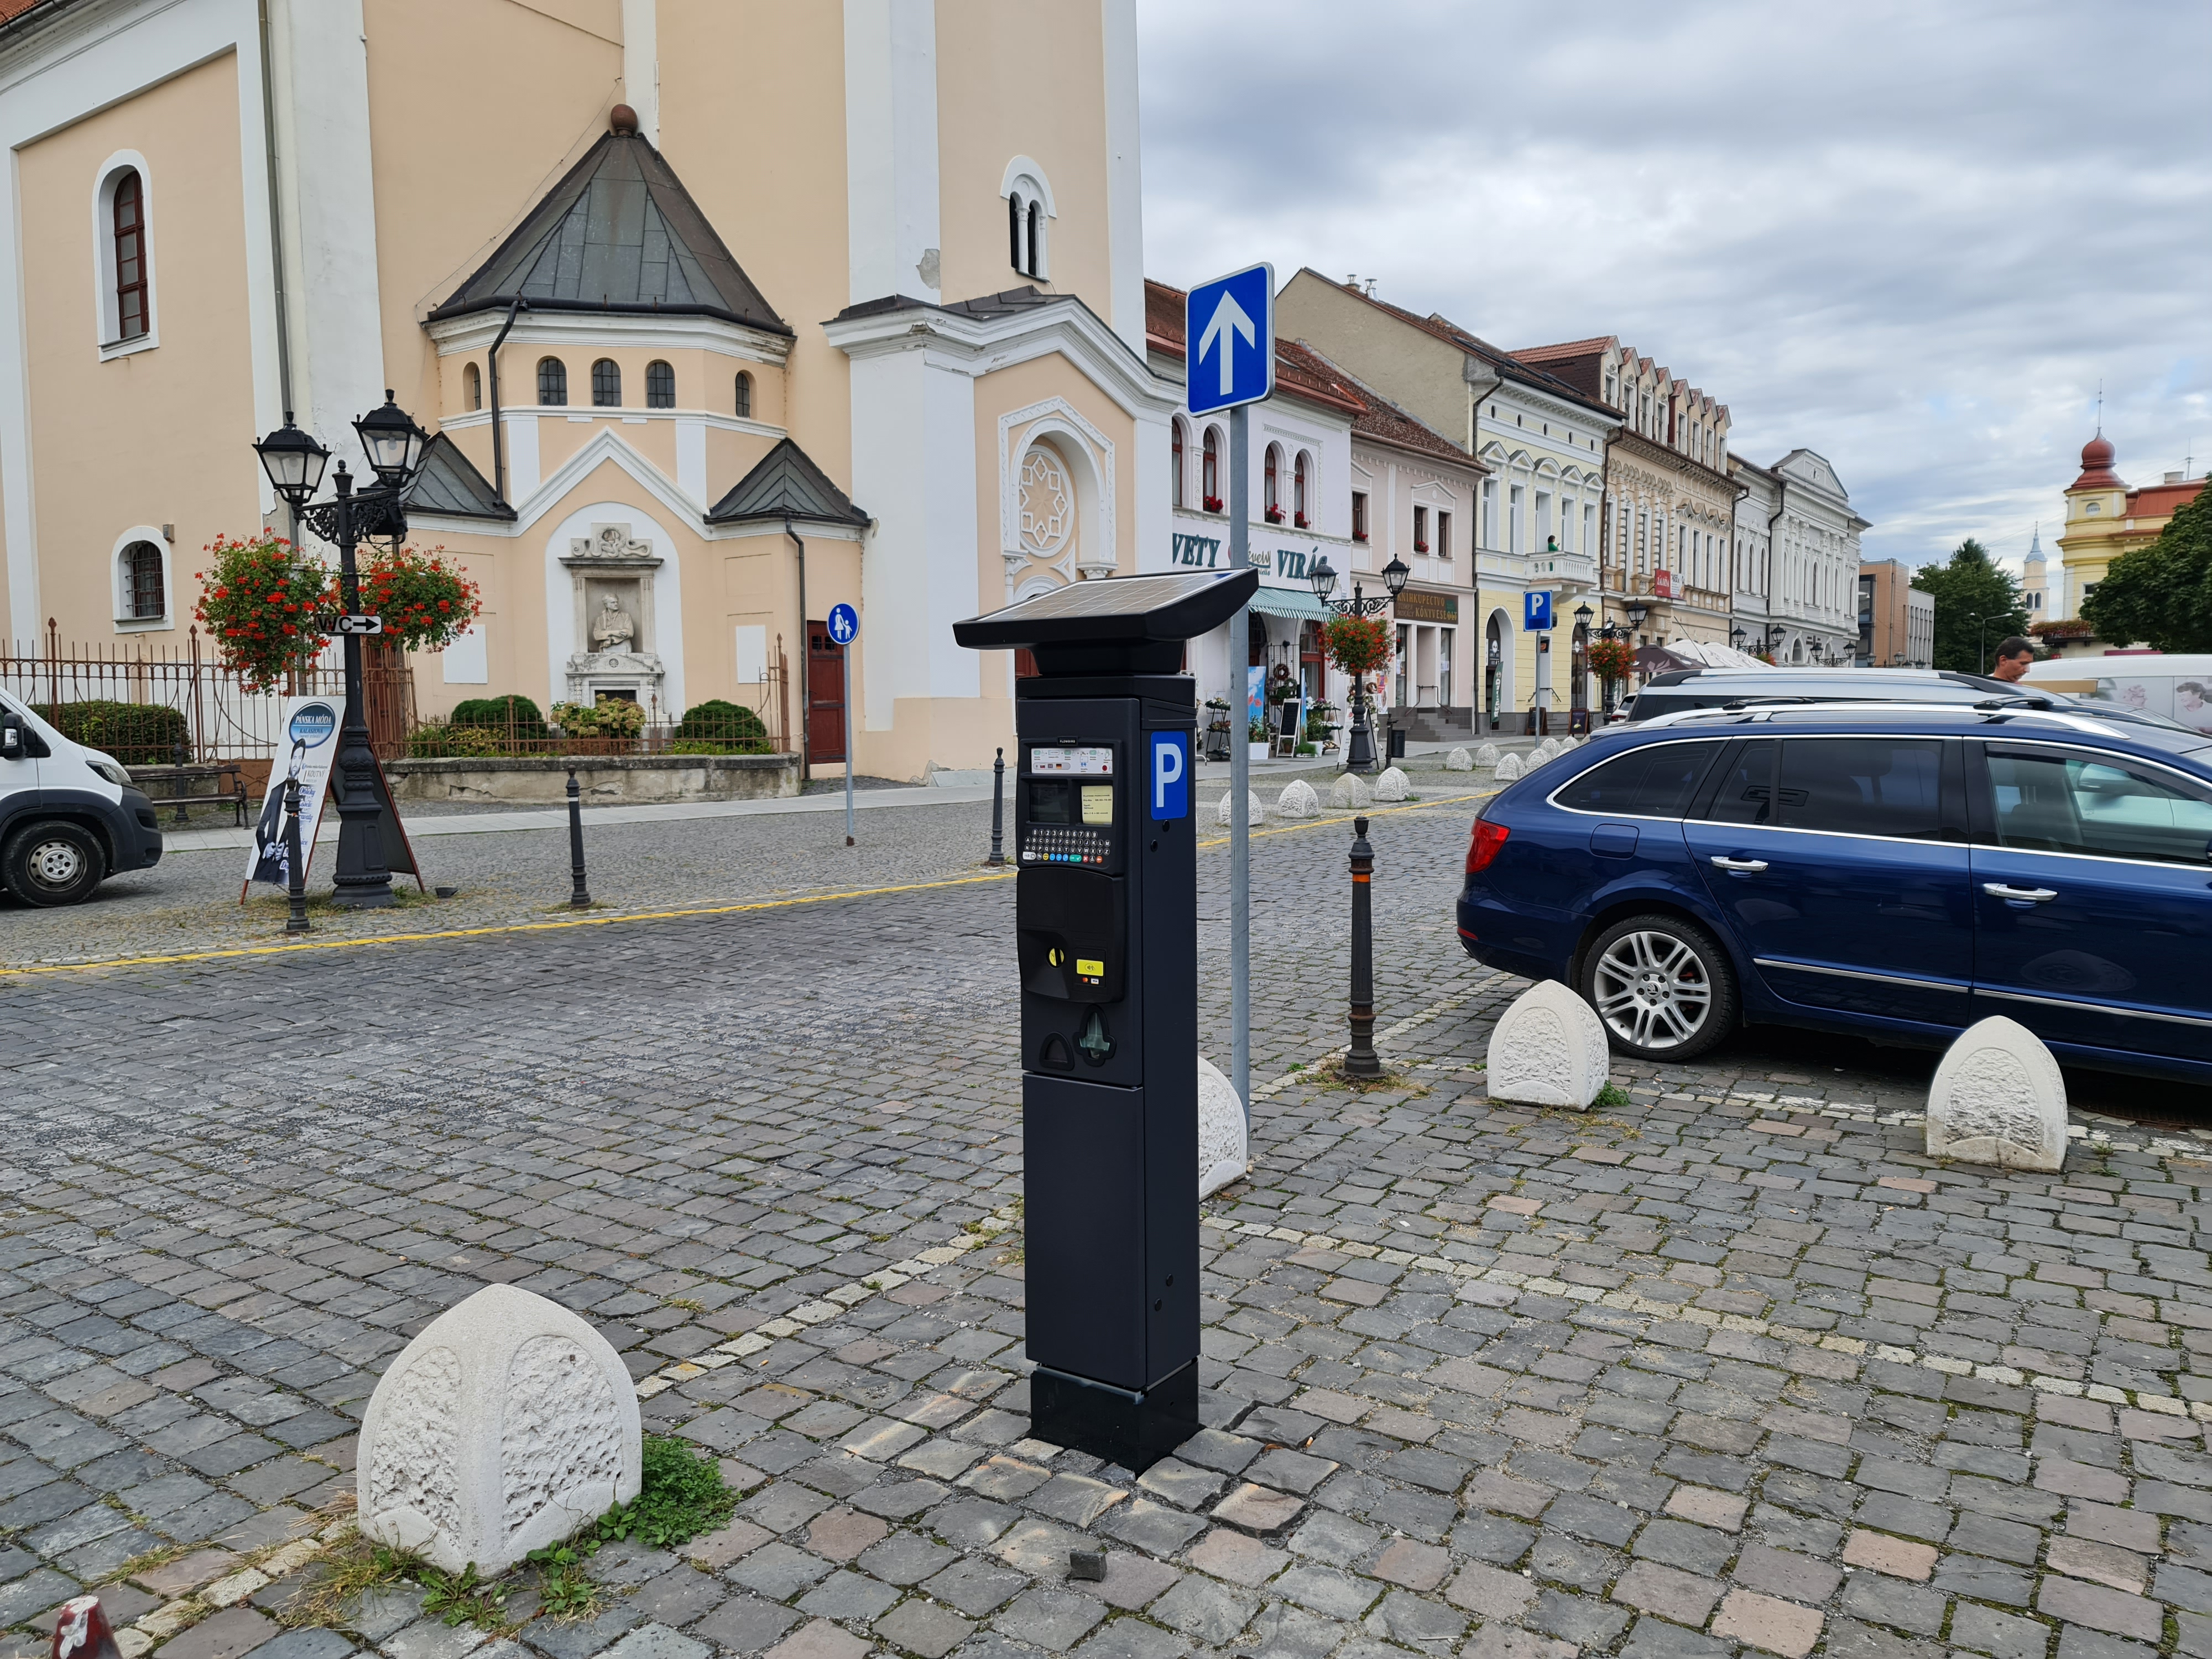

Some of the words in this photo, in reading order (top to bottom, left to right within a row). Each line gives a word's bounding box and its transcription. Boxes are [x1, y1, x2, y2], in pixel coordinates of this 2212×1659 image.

[1172, 533, 1220, 567] VETY
[1397, 589, 1445, 607] KNÍHKUPECTVO
[1532, 593, 1544, 615] P
[317, 616, 353, 632] WC
[295, 713, 314, 724] PÁNSKA
[314, 713, 331, 724] MÓDA
[1156, 743, 1182, 808] P
